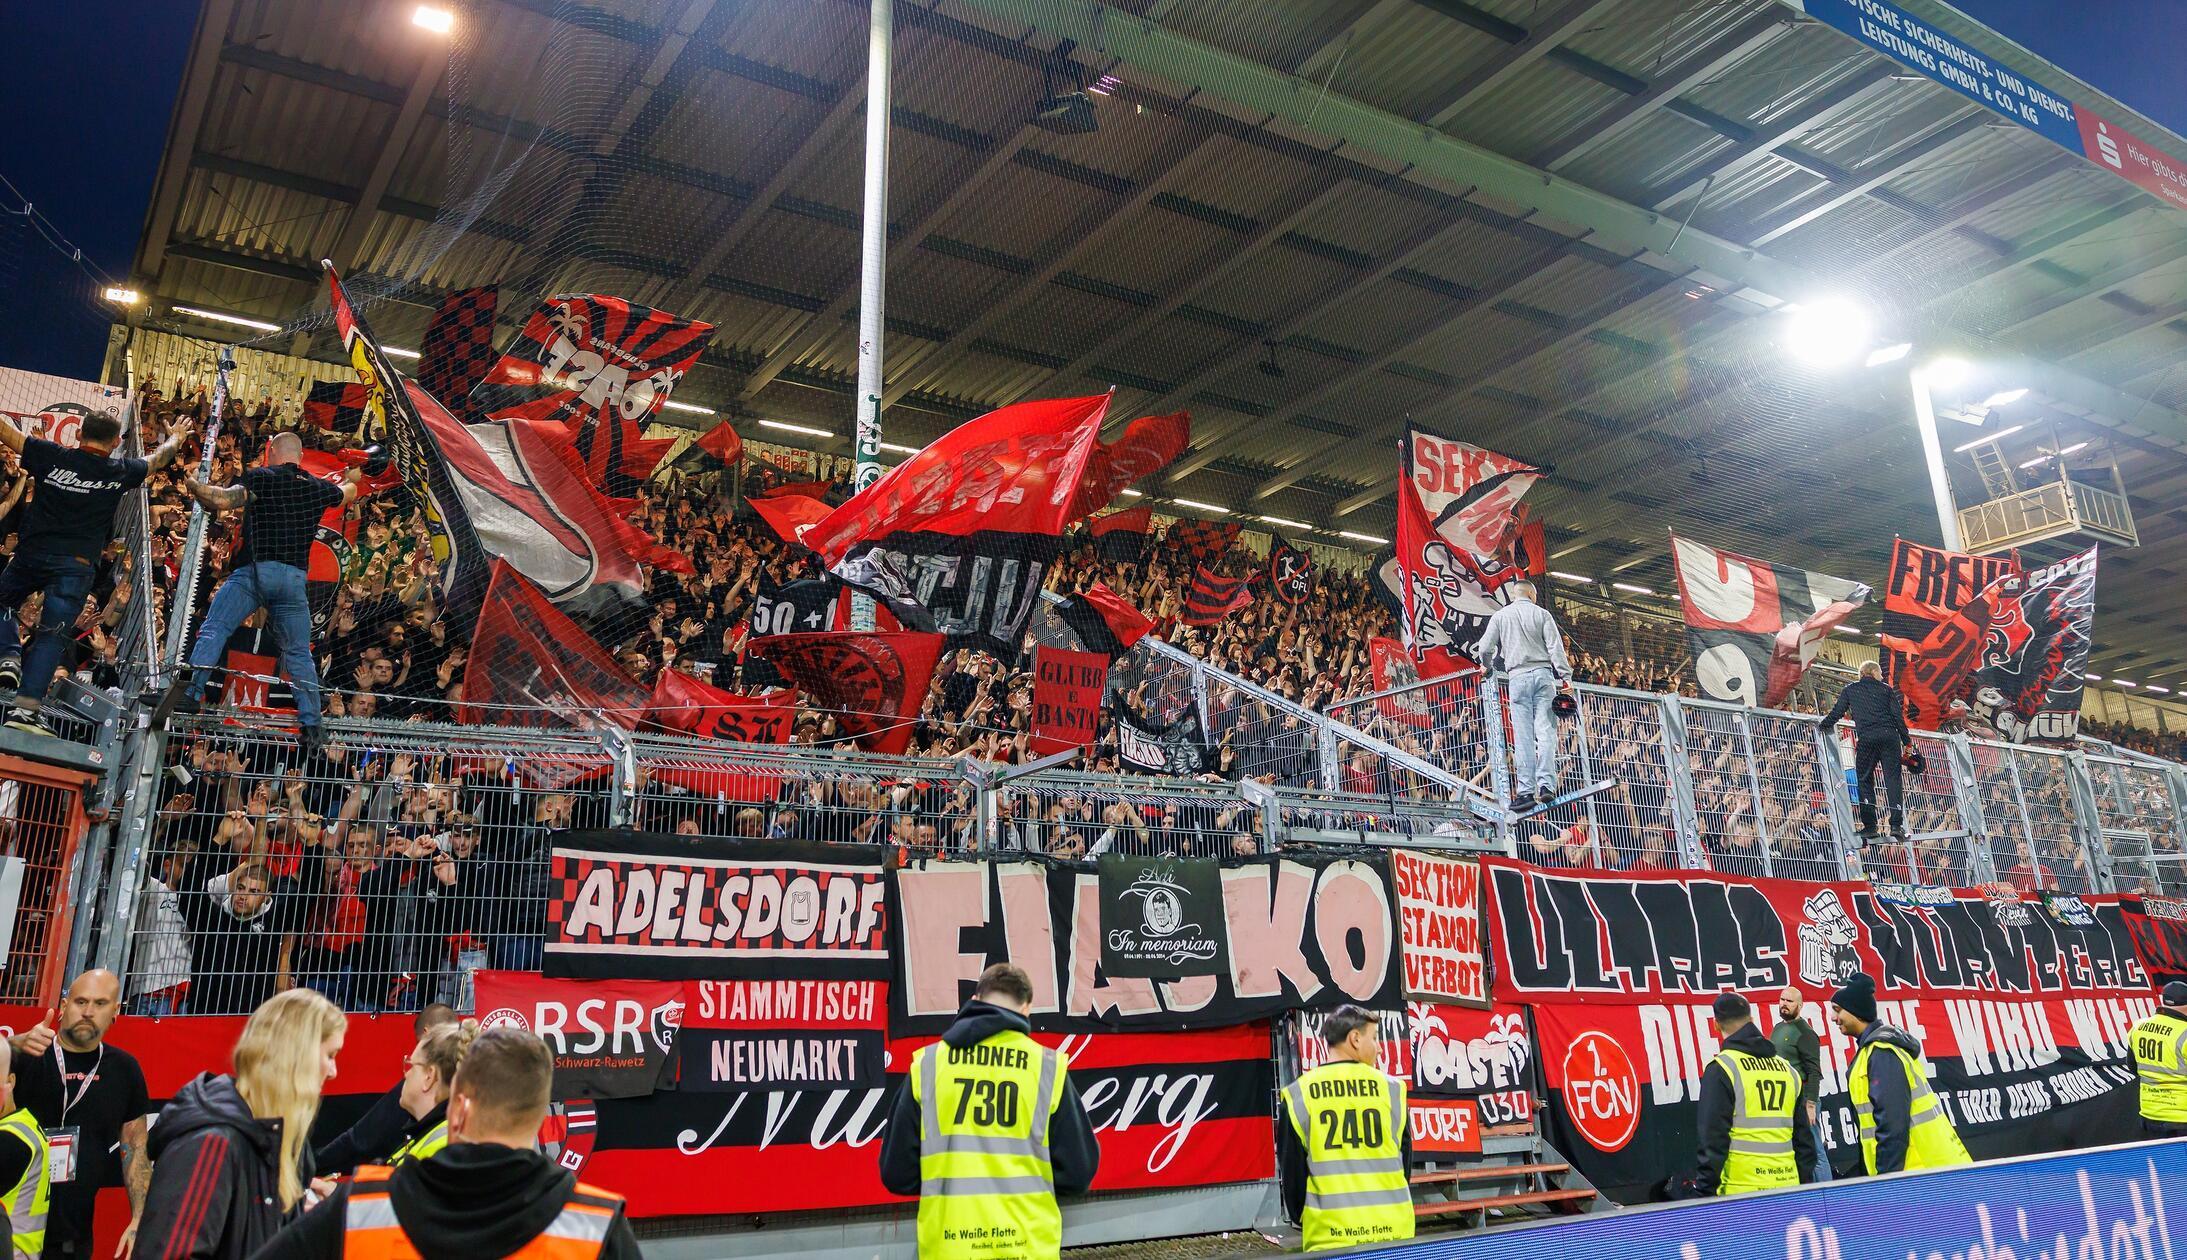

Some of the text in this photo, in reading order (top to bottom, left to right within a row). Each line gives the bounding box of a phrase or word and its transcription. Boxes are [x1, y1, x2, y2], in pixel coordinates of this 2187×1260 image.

[1859, 17, 2038, 125] LEISTUNGS GMBH & CO. KG
[1903, 19, 1994, 78] SICHERHEITS-
[1996, 68, 2025, 97] UND
[2027, 85, 2075, 121] DIENST-
[2127, 143, 2149, 168] Hier
[2151, 159, 2178, 183] gibts
[754, 594, 795, 635] 50
[1036, 703, 1094, 729] BASTA
[1395, 852, 1477, 910] SEKTION
[565, 868, 885, 944] ADELSDORF
[1108, 929, 1218, 953] In memoriam
[1402, 906, 1481, 954] STADION
[1488, 865, 1791, 994] ULTRAS
[1405, 953, 1481, 998] VERBOT
[699, 980, 875, 1022] STAMMTISCH
[535, 999, 645, 1054] RSR
[2138, 1022, 2173, 1037] ORDNER
[711, 1039, 858, 1082] NEUMARKT
[948, 1045, 1029, 1070] ORDNER
[1740, 1056, 1787, 1072] ORDNER
[2138, 1037, 2163, 1062] 901
[953, 1078, 1018, 1128] 730
[1309, 1079, 1379, 1100] ORDNER
[1571, 1078, 1633, 1120] FCN
[1756, 1079, 1786, 1111] 127
[1956, 1088, 2002, 1124] ÜBER
[1319, 1108, 1383, 1151] 240
[1407, 1106, 1471, 1142] DORF
[944, 1229, 956, 1240] Die
[992, 1226, 1016, 1238] Flotte
[1330, 1227, 1342, 1237] Die
[1372, 1225, 1393, 1234] Flotte
